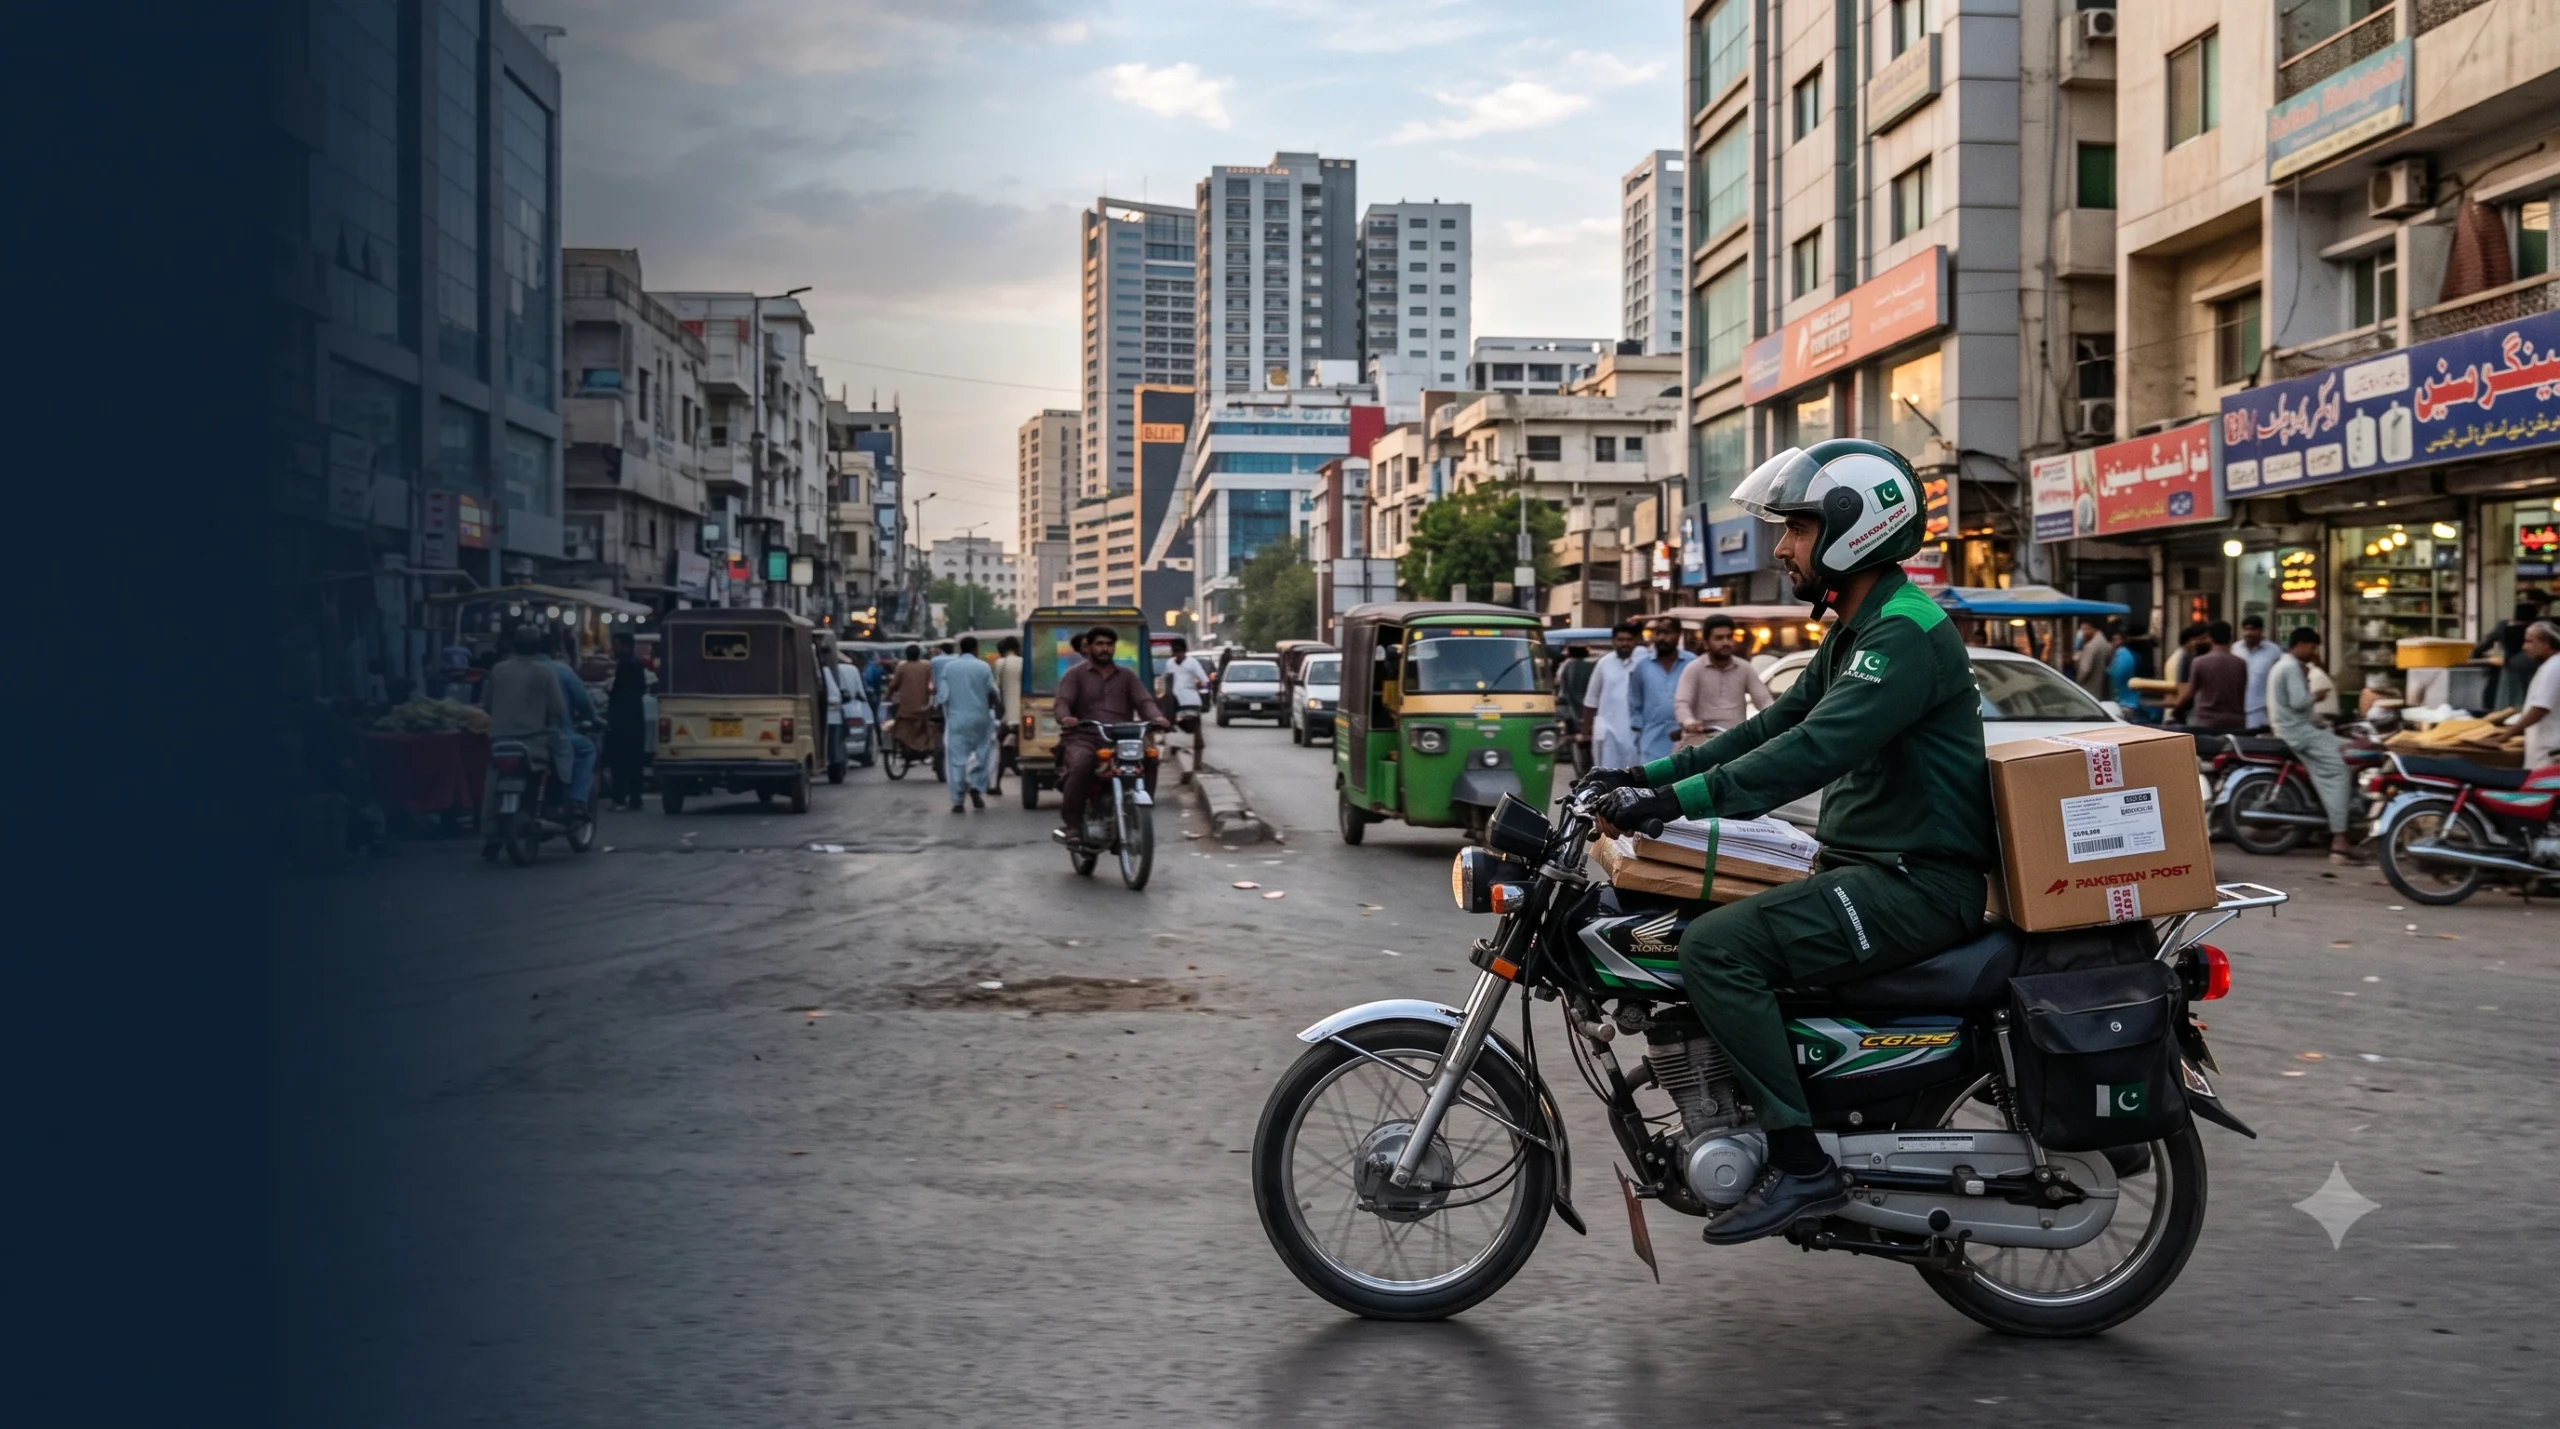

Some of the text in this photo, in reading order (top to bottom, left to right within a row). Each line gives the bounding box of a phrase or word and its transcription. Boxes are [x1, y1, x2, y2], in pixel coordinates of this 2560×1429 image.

[2076, 865, 2192, 889] PAKISTAN POST
[1861, 1032, 1956, 1047] CG125
